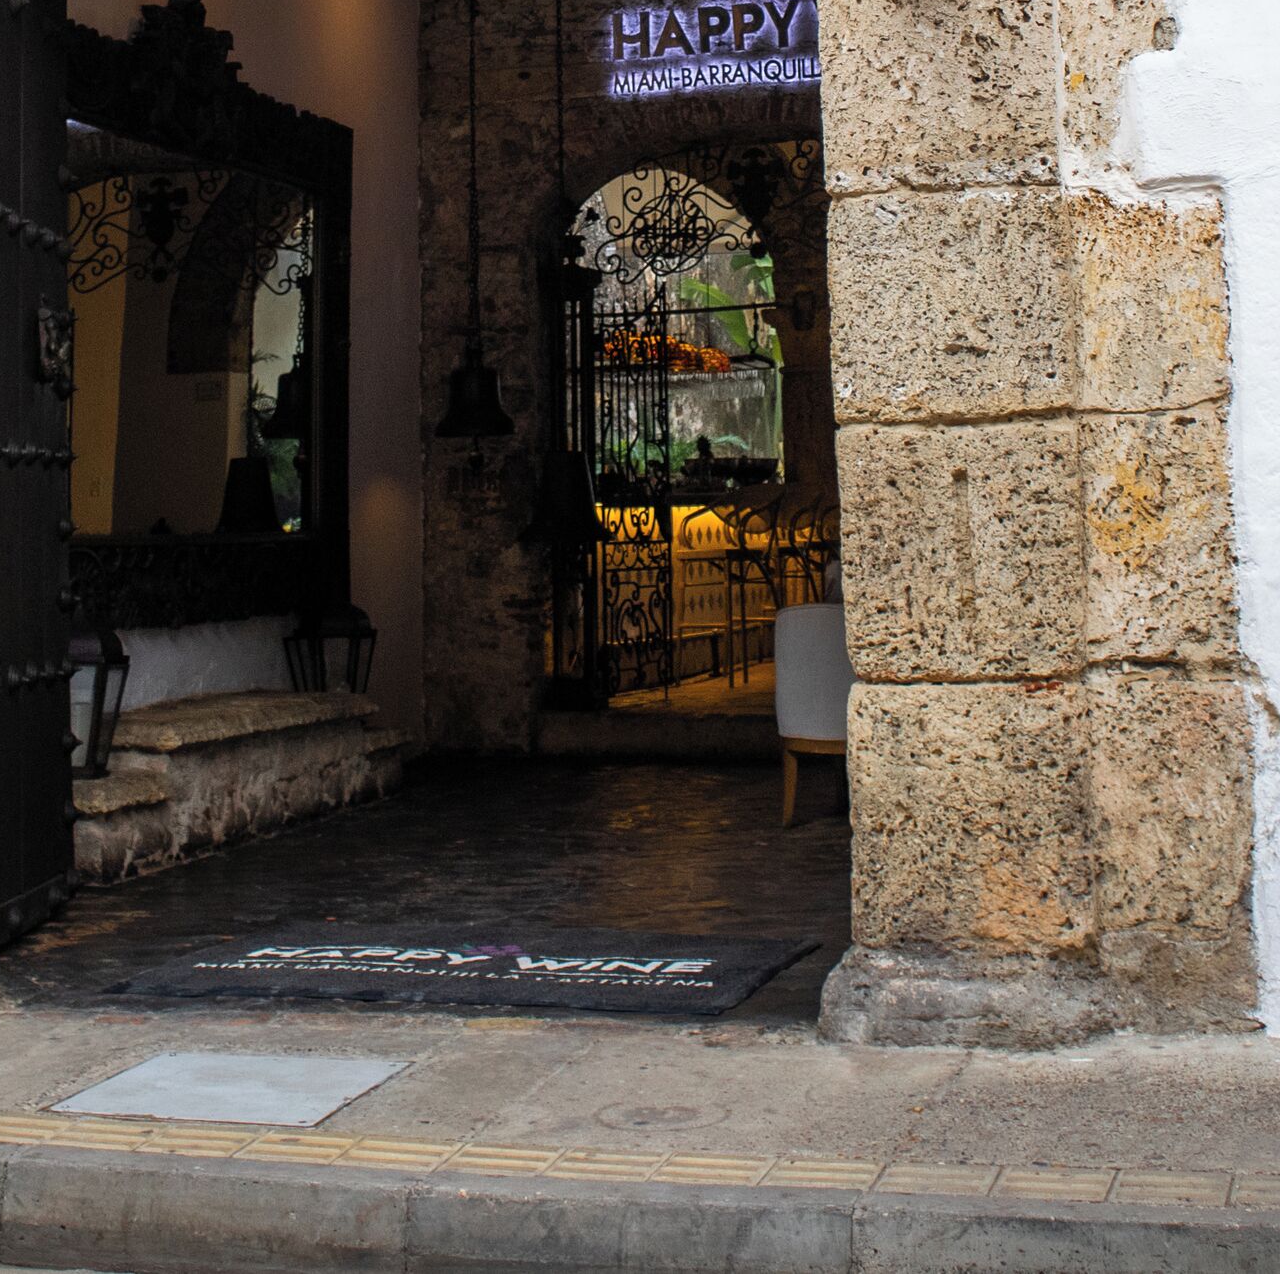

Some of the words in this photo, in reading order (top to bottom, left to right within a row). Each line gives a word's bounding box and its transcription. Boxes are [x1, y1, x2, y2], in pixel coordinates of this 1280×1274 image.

[613, 0, 800, 59] HAPPY
[246, 948, 491, 965] HAPPY
[516, 956, 713, 974] WINE
